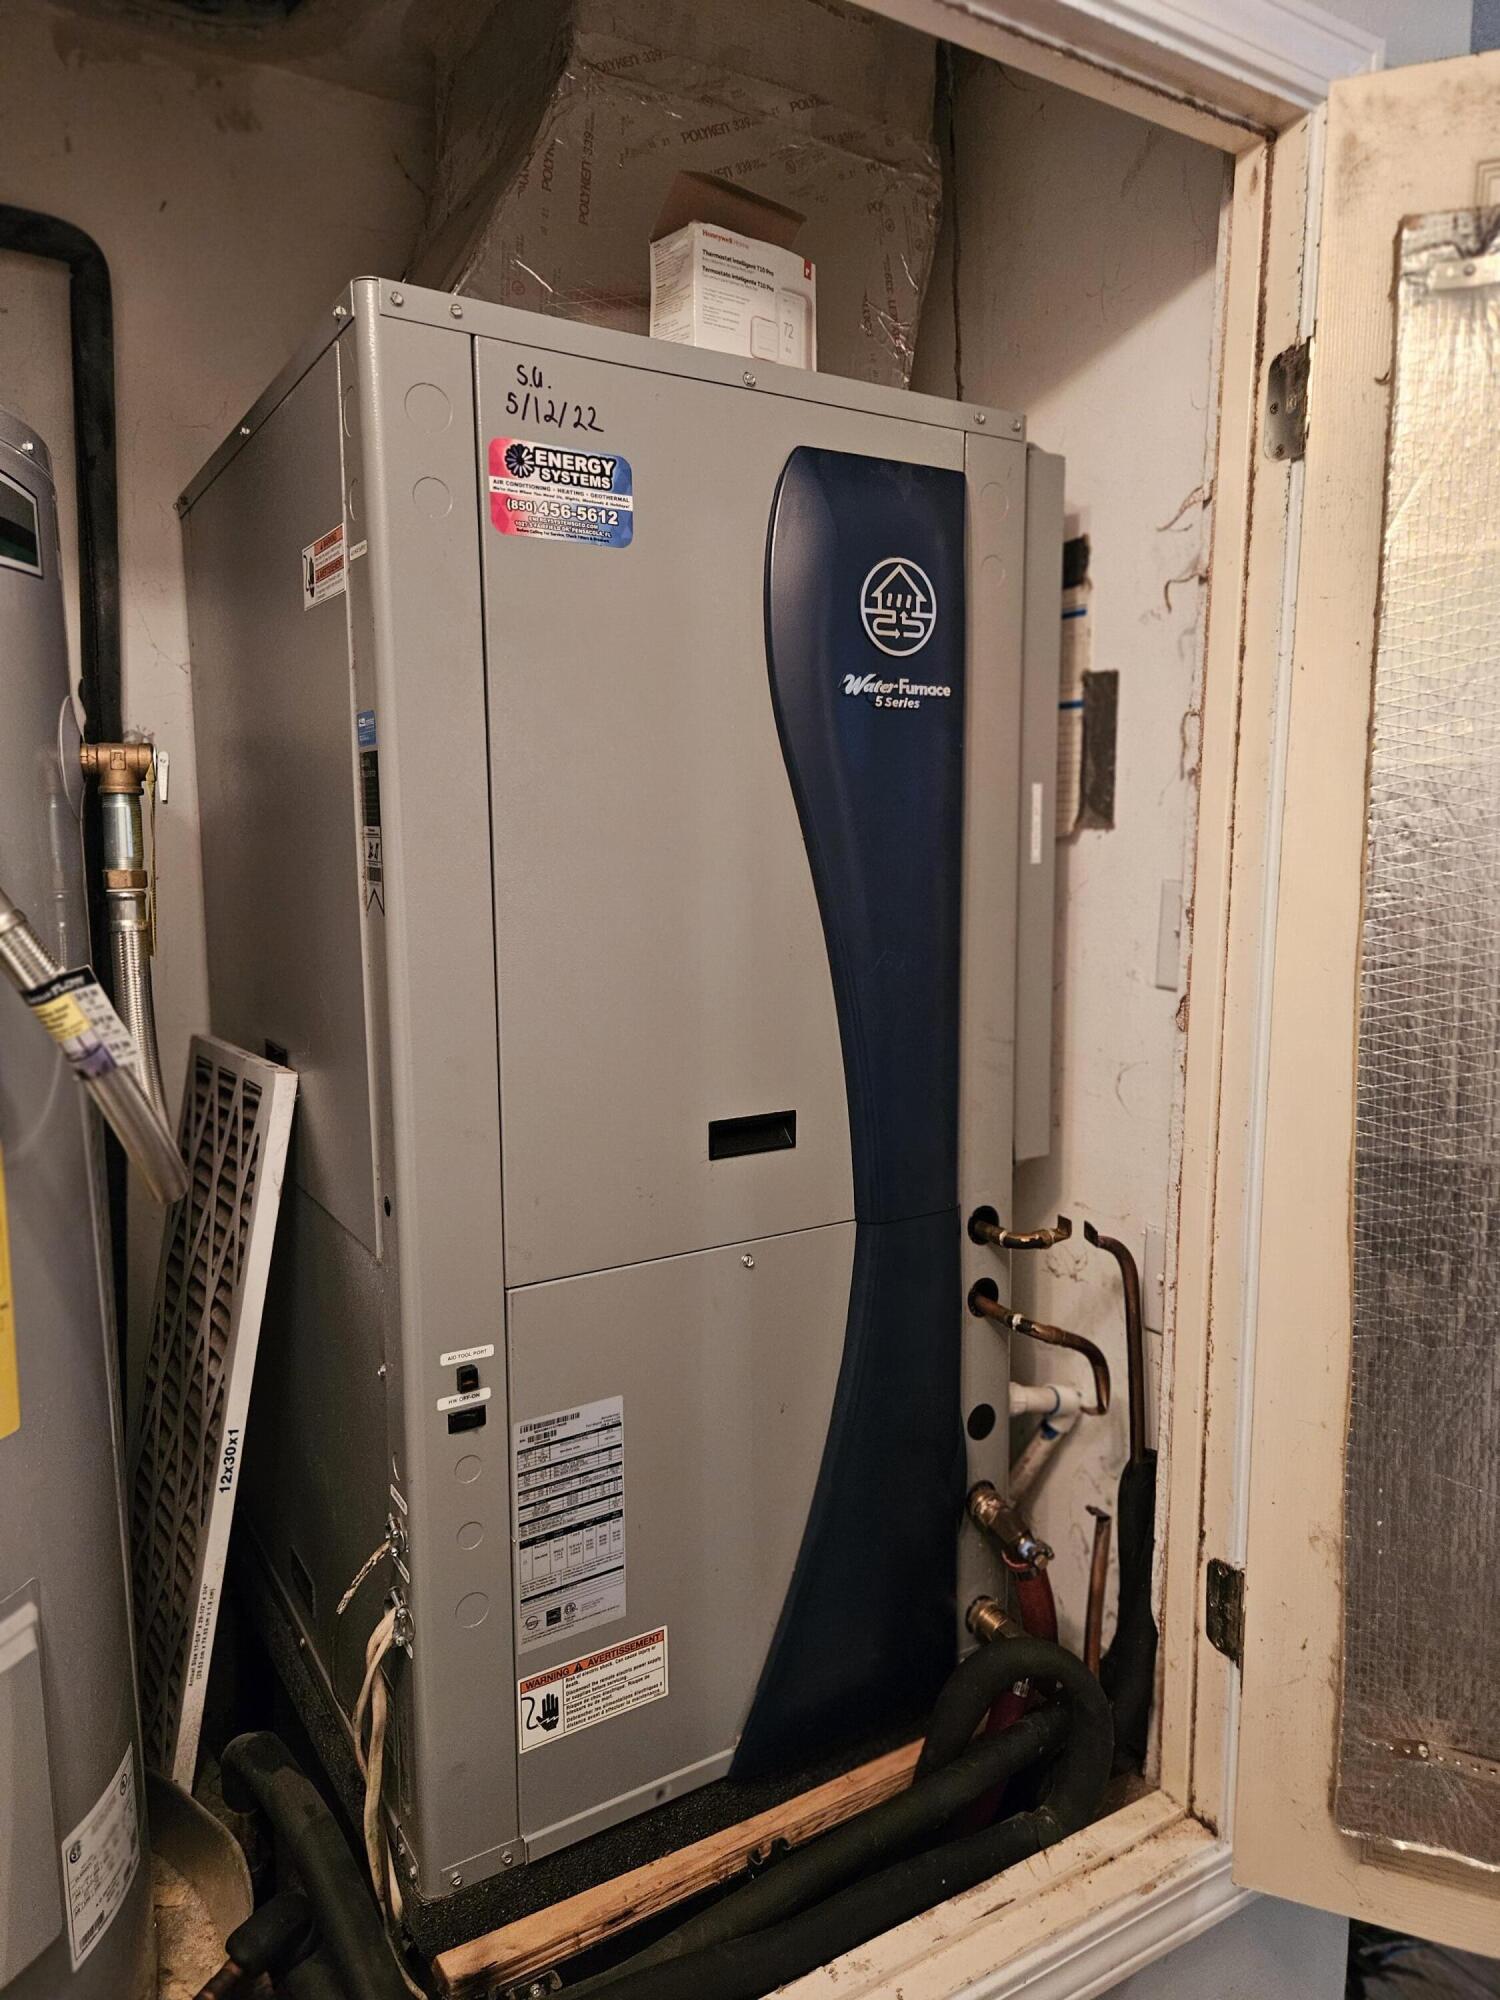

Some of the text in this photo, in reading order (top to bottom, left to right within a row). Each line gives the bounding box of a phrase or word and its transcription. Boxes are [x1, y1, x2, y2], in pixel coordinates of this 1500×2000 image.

[681, 121, 731, 145] POLYKEN
[733, 117, 751, 132] 339
[578, 161, 593, 226] POLYKEN
[702, 229, 733, 244] Honeywell
[702, 249, 731, 262] Thermostat
[766, 268, 775, 277] Pro
[702, 265, 731, 279] Termostato
[732, 273, 757, 287] inteligente
[767, 284, 775, 293] Pro
[783, 321, 795, 340] 72
[506, 391, 605, 433] 5/12/22
[535, 449, 615, 476] ENERGY
[505, 480, 550, 491] CONDITIONING
[557, 488, 584, 496] HEATING
[590, 492, 629, 502] GEOTHERMAL
[541, 468, 612, 489] SYSTEMS
[507, 498, 619, 525] (850) 456-5612
[874, 695, 920, 709] 5 Series
[218, 1429, 240, 1494] 12x30x1
[525, 1633, 662, 1690] WARNING AVERTISSEMENT
[582, 1666, 598, 1676] electric
[624, 1652, 636, 1660] cause
[566, 1682, 590, 1696] Disconnect
[599, 1673, 614, 1683] remote
[616, 1666, 632, 1677] electric
[633, 1661, 646, 1670] power
[647, 1655, 660, 1664] supply
[566, 1700, 582, 1710] Risque
[627, 1676, 642, 1686] Risque
[571, 1689, 590, 1700] supplies
[591, 1683, 605, 1692] before
[602, 1692, 632, 1708] alimentations
[566, 1704, 585, 1715] blessure
[566, 1717, 585, 1728] distance
[587, 1711, 599, 1720] avant
